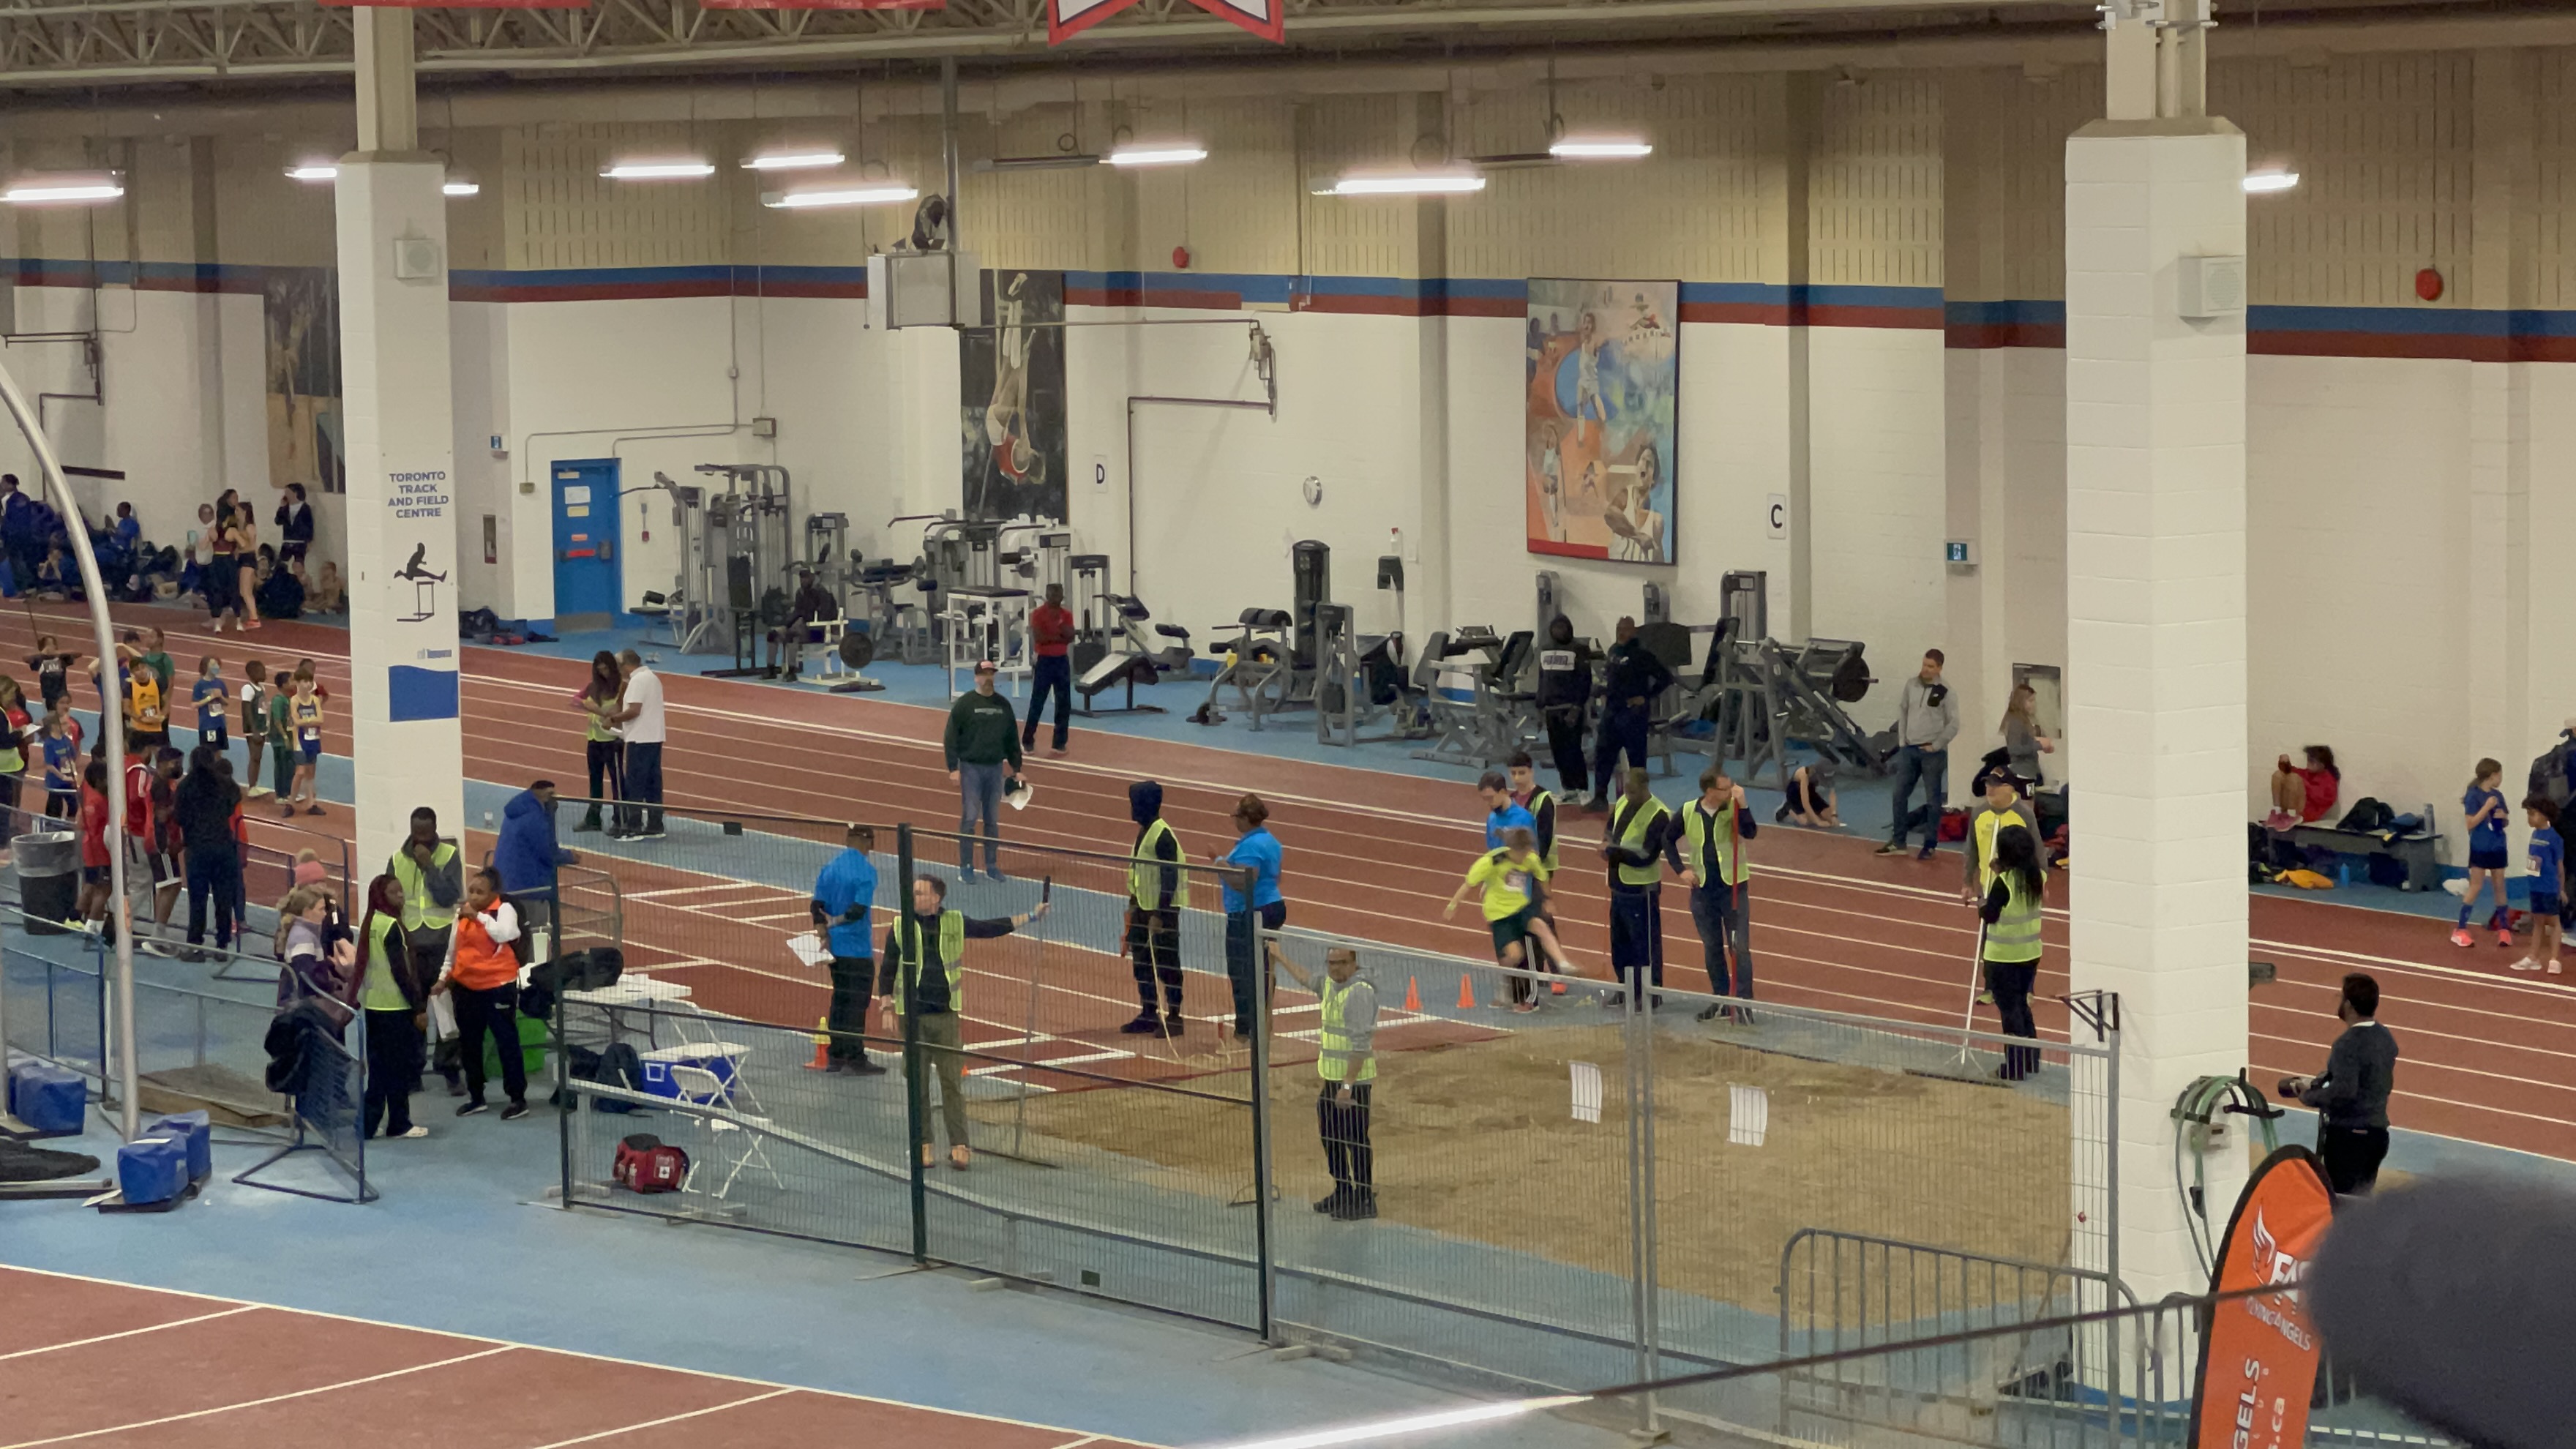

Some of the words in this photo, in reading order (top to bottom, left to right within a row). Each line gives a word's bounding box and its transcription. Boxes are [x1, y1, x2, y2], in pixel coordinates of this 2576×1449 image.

[389, 471, 446, 483] TORONTO
[1096, 463, 1105, 484] D
[398, 483, 438, 495] TRACK
[387, 497, 413, 507] AND
[416, 495, 449, 506] FIELD
[395, 507, 442, 519] CENTRE
[1771, 503, 1783, 529] C
